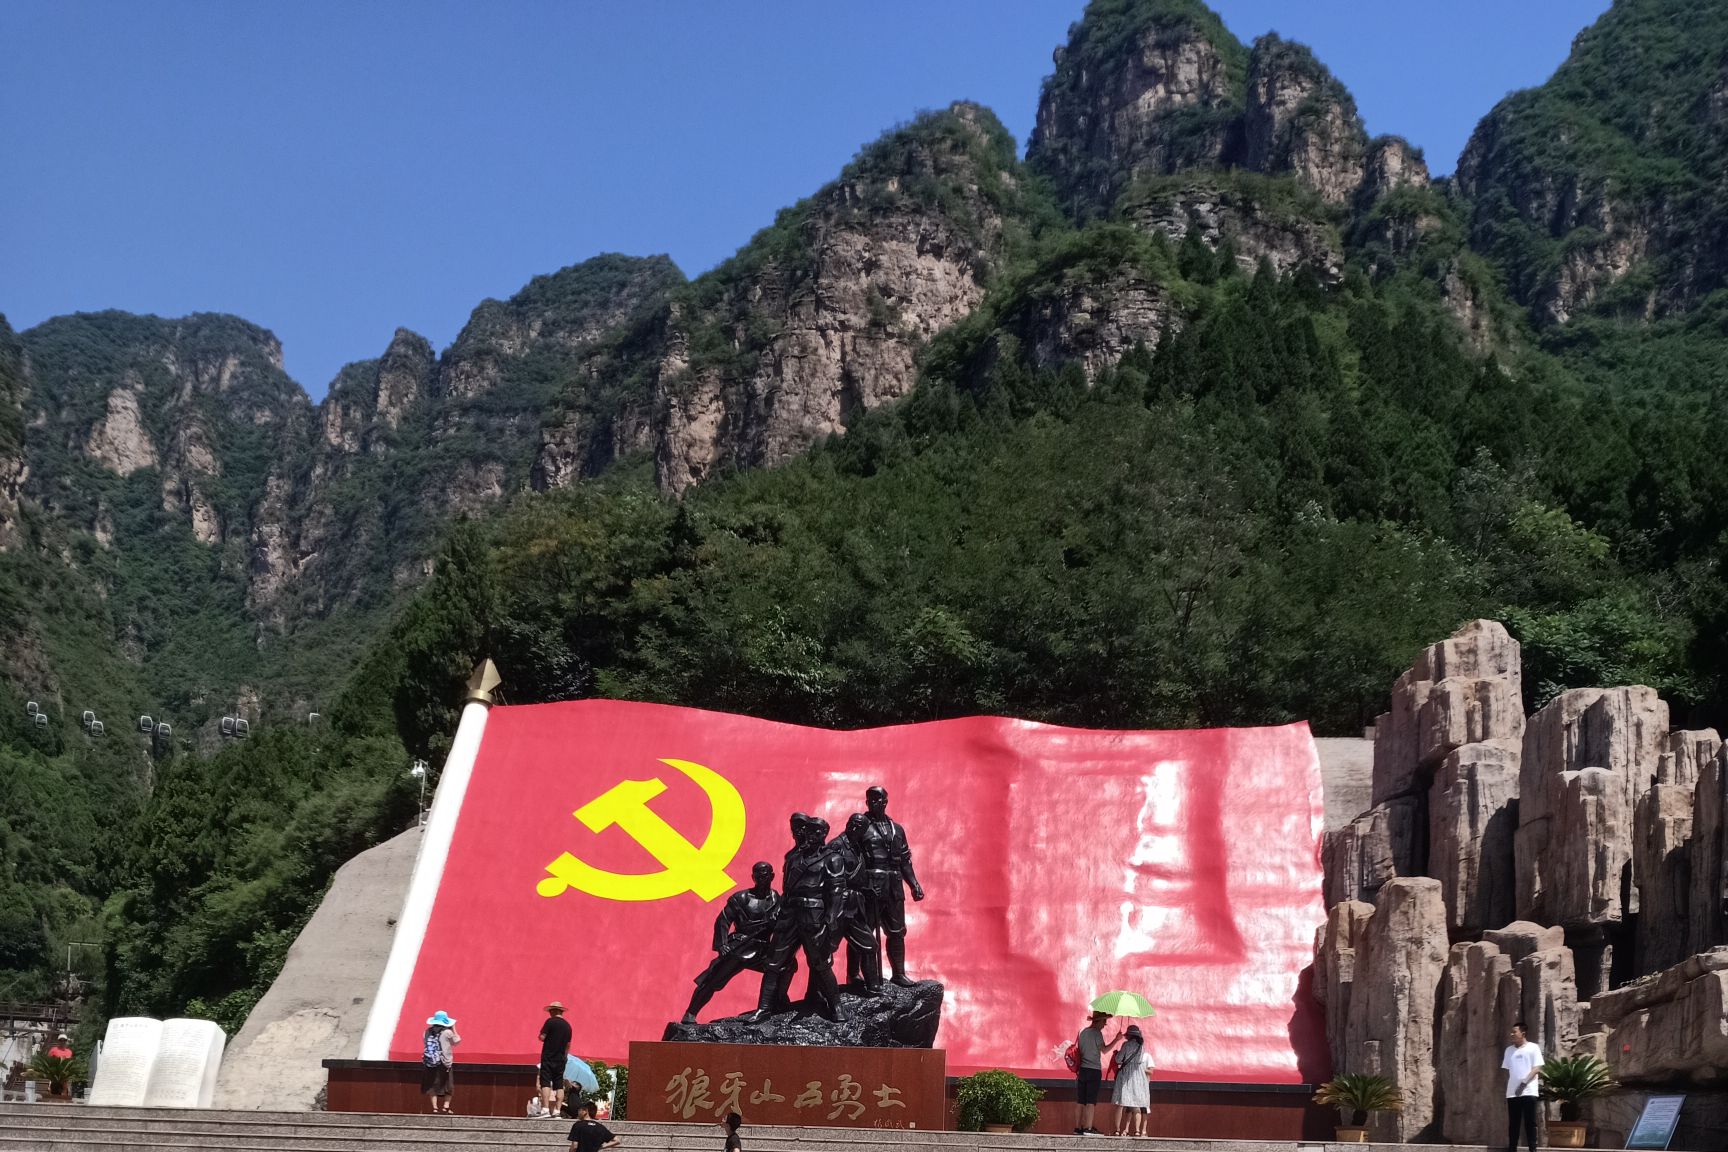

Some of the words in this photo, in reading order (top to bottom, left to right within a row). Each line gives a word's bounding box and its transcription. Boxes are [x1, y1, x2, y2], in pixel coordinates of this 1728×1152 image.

[665, 1067, 906, 1119] 狼牙山五勇士
